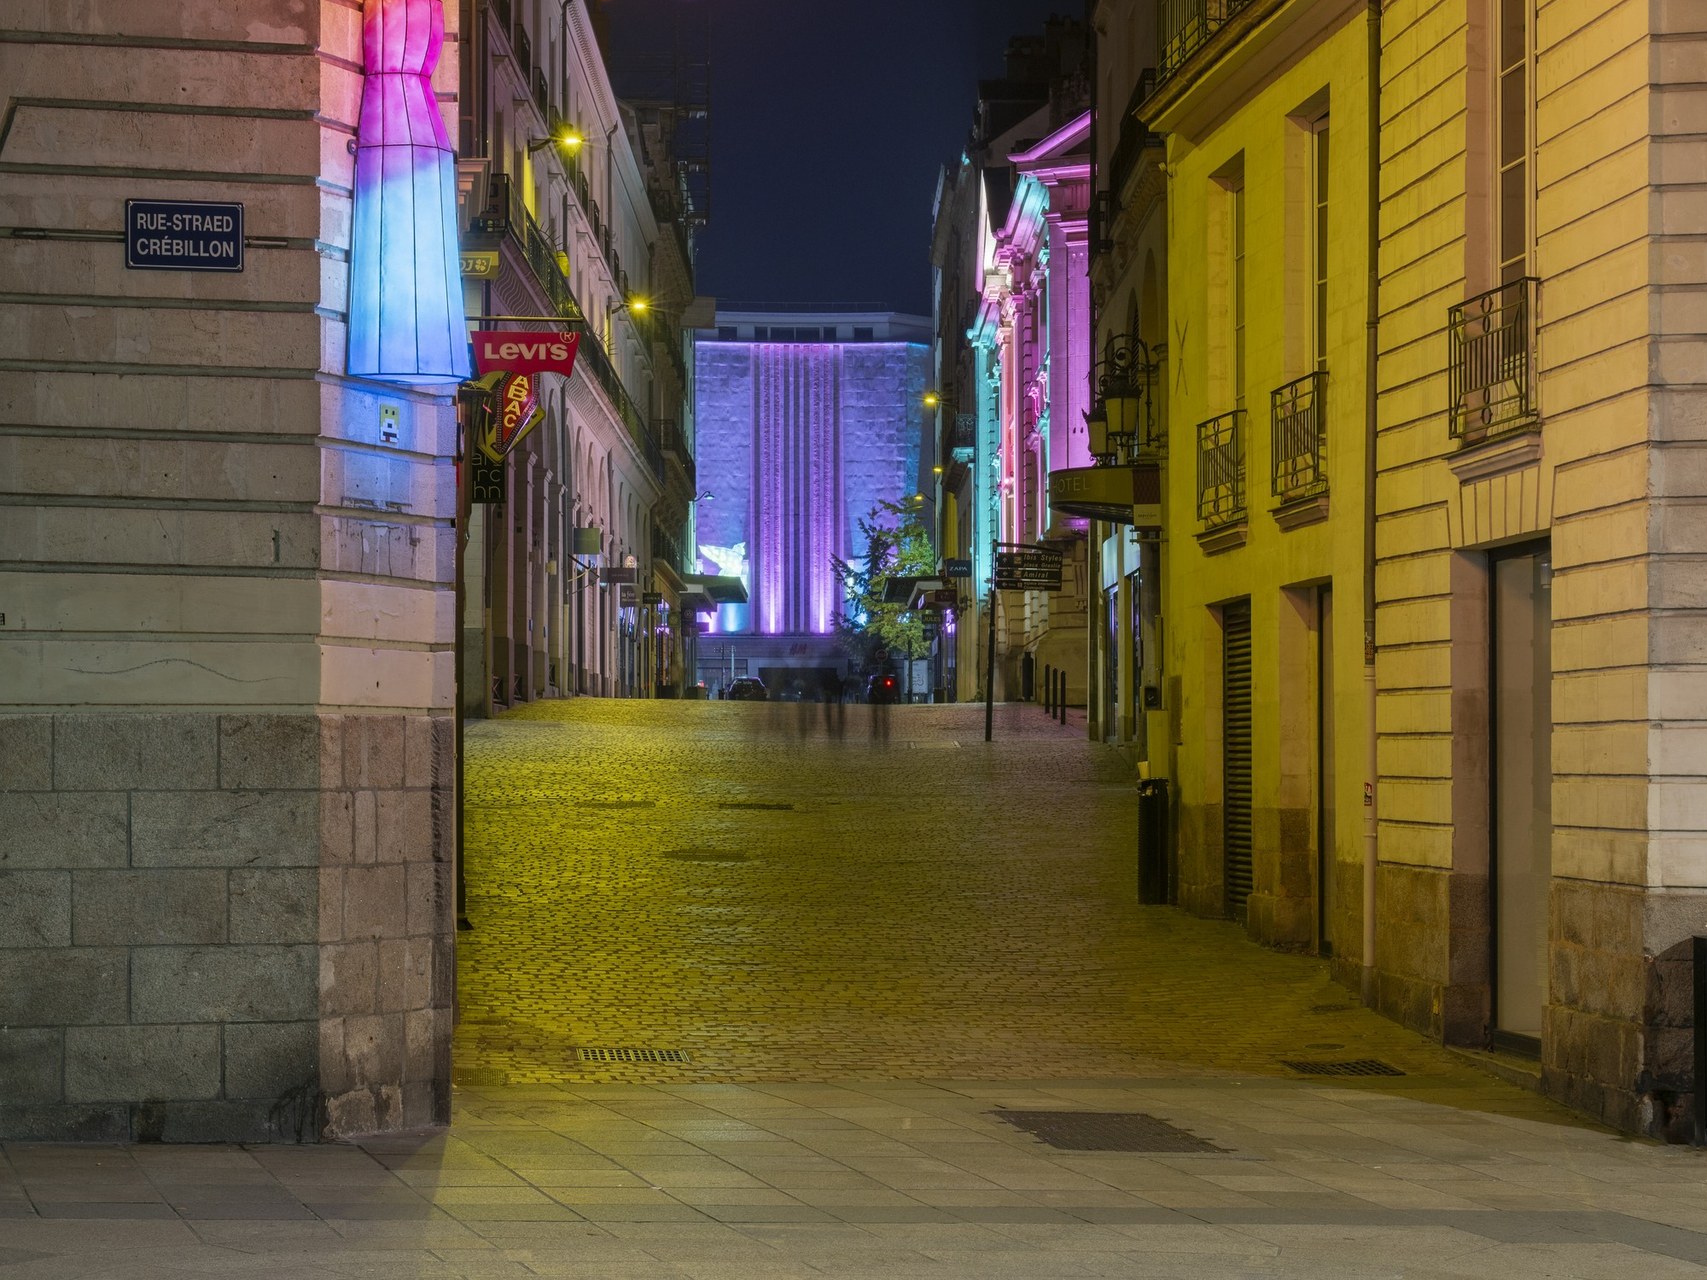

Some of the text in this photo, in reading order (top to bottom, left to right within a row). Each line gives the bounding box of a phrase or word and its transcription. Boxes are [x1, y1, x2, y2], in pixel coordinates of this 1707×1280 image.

[136, 213, 233, 232] RUE-STRAED
[136, 235, 234, 258] CRÉBILLON
[459, 259, 473, 271] DJ
[503, 375, 529, 428] ABAC
